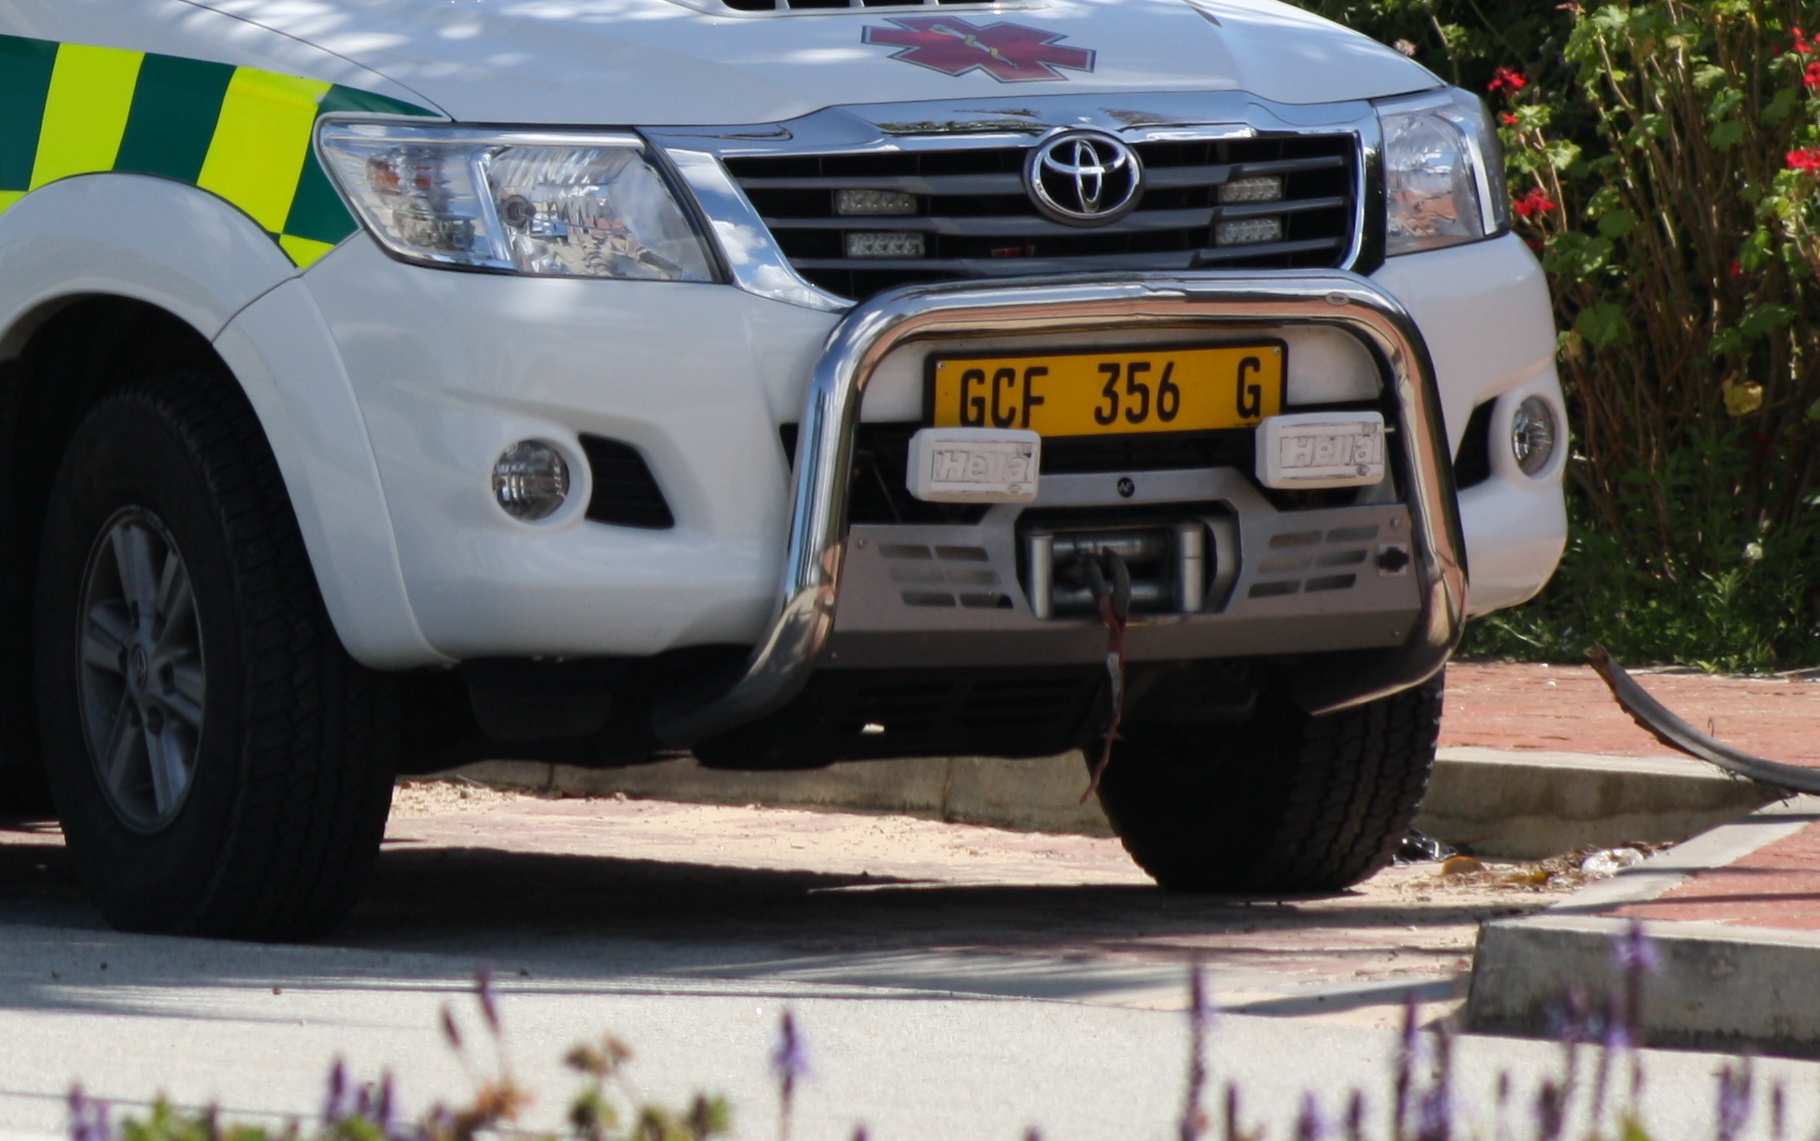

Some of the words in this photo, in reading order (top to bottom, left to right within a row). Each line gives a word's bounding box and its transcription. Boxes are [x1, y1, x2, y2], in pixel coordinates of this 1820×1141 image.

[960, 365, 1047, 428] GCF
[1093, 361, 1180, 426] 356
[1236, 356, 1261, 420] G
